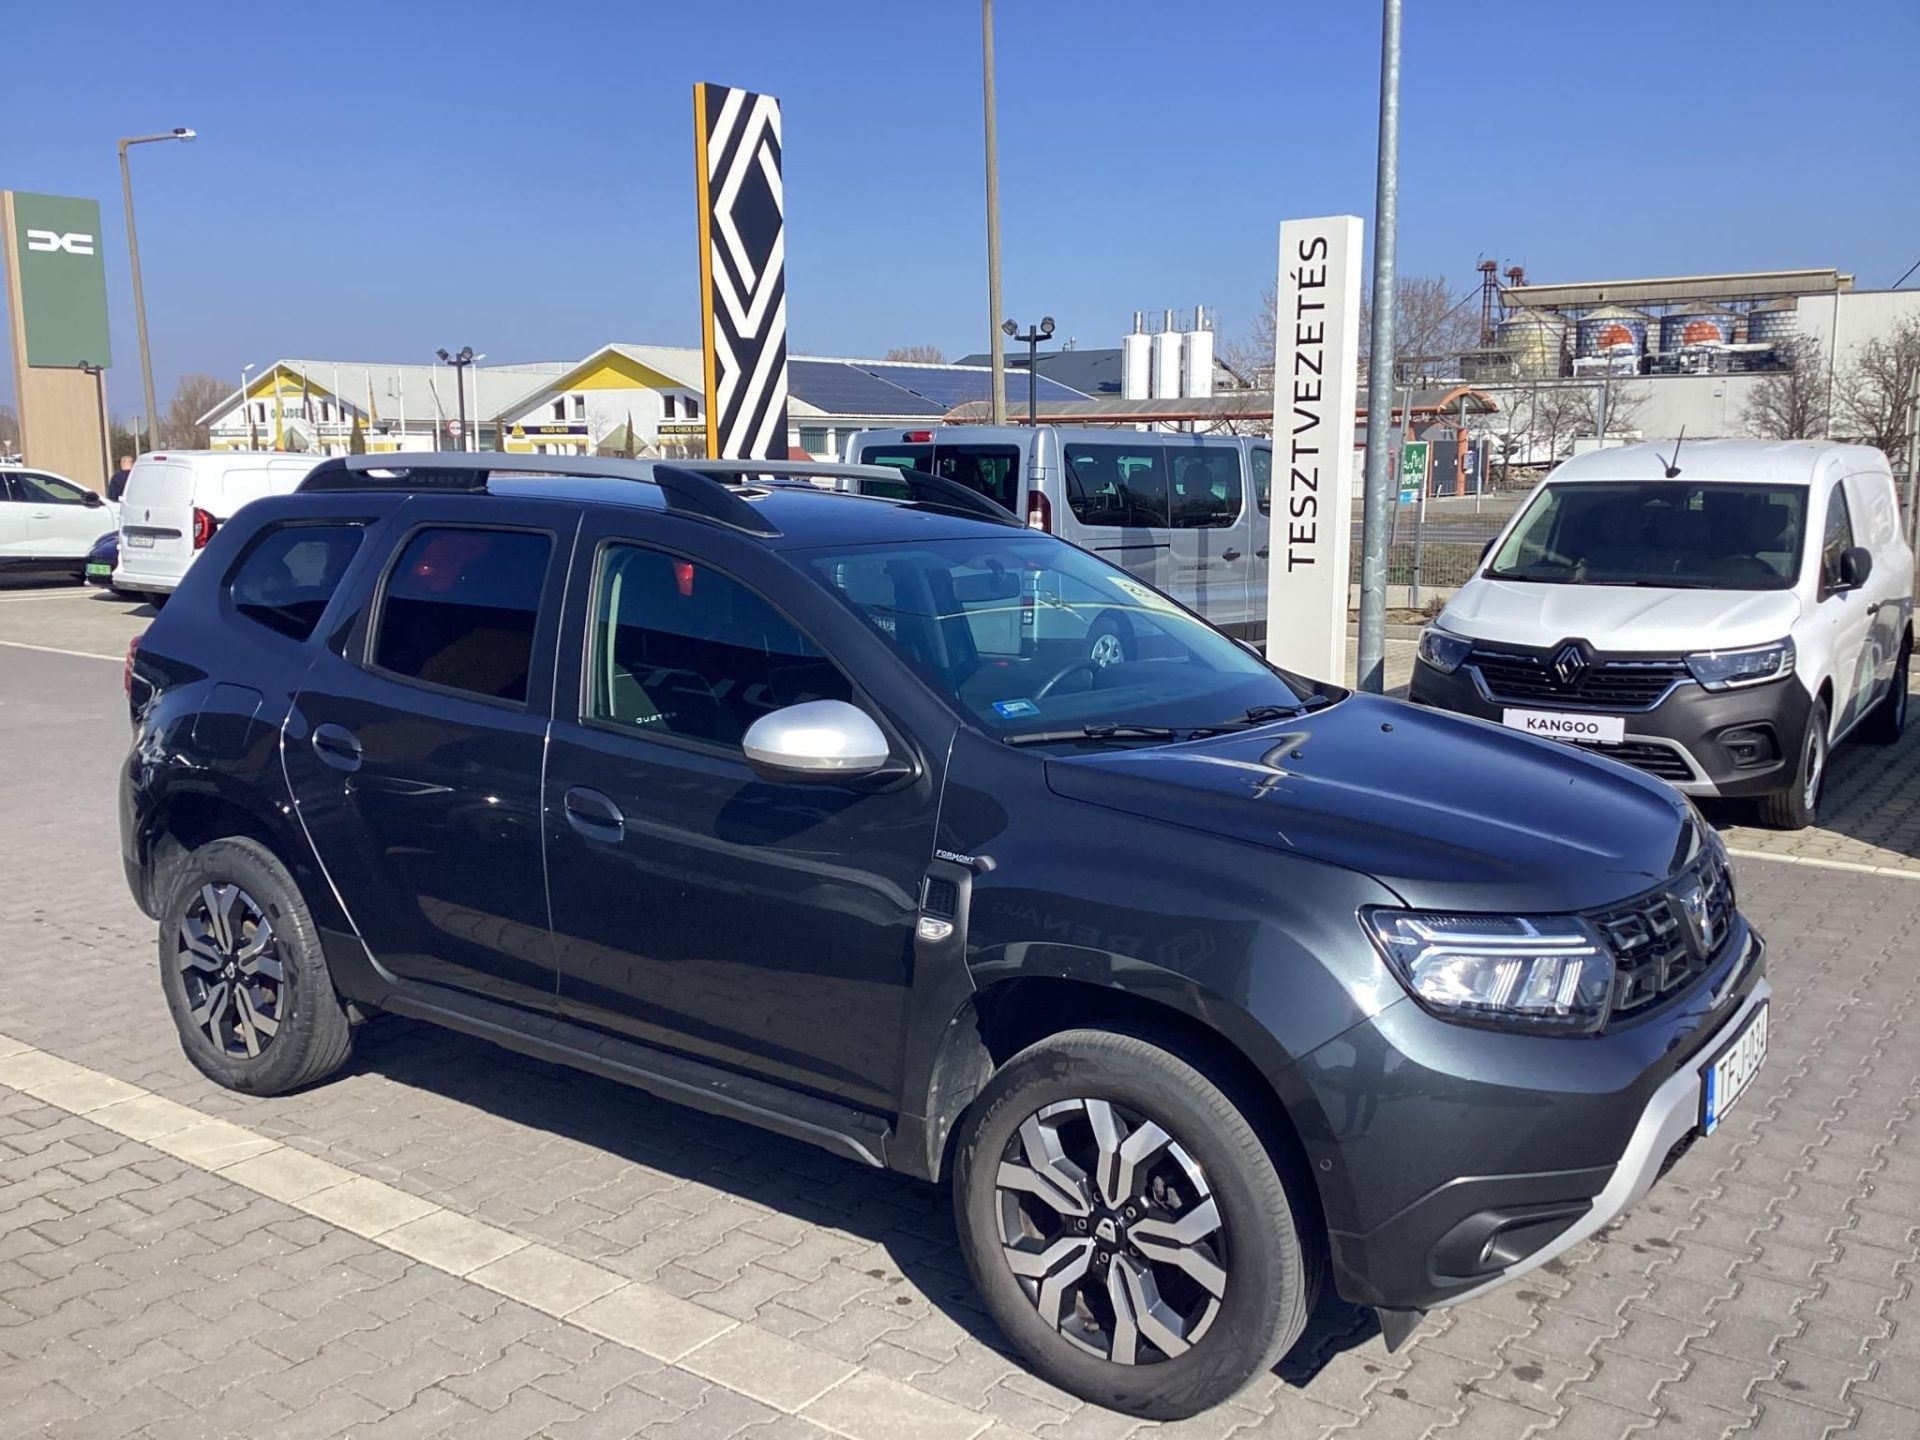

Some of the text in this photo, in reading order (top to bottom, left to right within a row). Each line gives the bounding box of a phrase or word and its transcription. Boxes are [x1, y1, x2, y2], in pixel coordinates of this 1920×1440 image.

[1287, 235, 1329, 572] TESZTVEZETÉS
[1526, 717, 1599, 734] KANGOO
[936, 849, 975, 864] FORMONT
